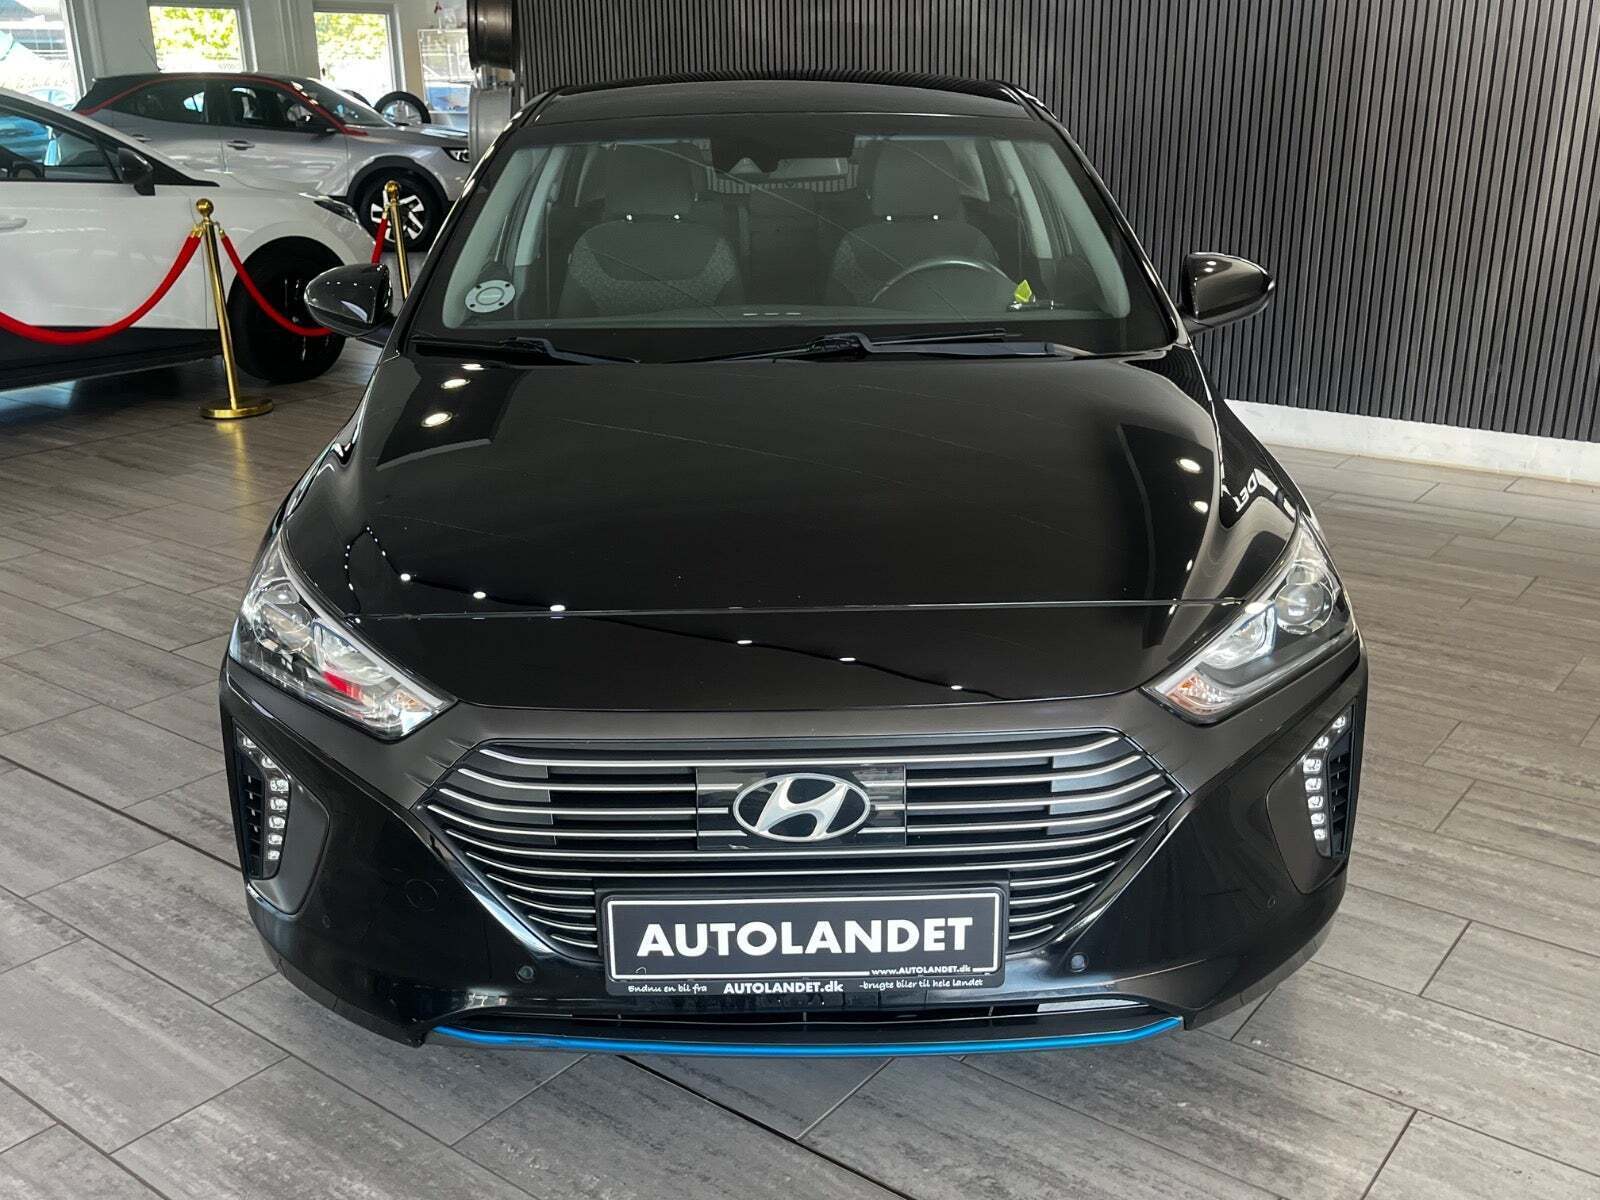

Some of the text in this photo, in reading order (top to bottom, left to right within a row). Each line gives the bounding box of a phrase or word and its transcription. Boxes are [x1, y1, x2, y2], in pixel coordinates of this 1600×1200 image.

[637, 917, 973, 957] AUTOLANDET
[871, 964, 972, 976] www.AUTOLANDET.dk
[628, 984, 661, 993] Endnu
[664, 985, 676, 993] en
[678, 983, 691, 993] bil
[692, 983, 708, 995] fra
[723, 981, 844, 995] AUTOLANDET.dk
[896, 980, 917, 990] biler
[919, 979, 930, 988] til
[933, 979, 950, 988] hele
[952, 978, 984, 987] landet
